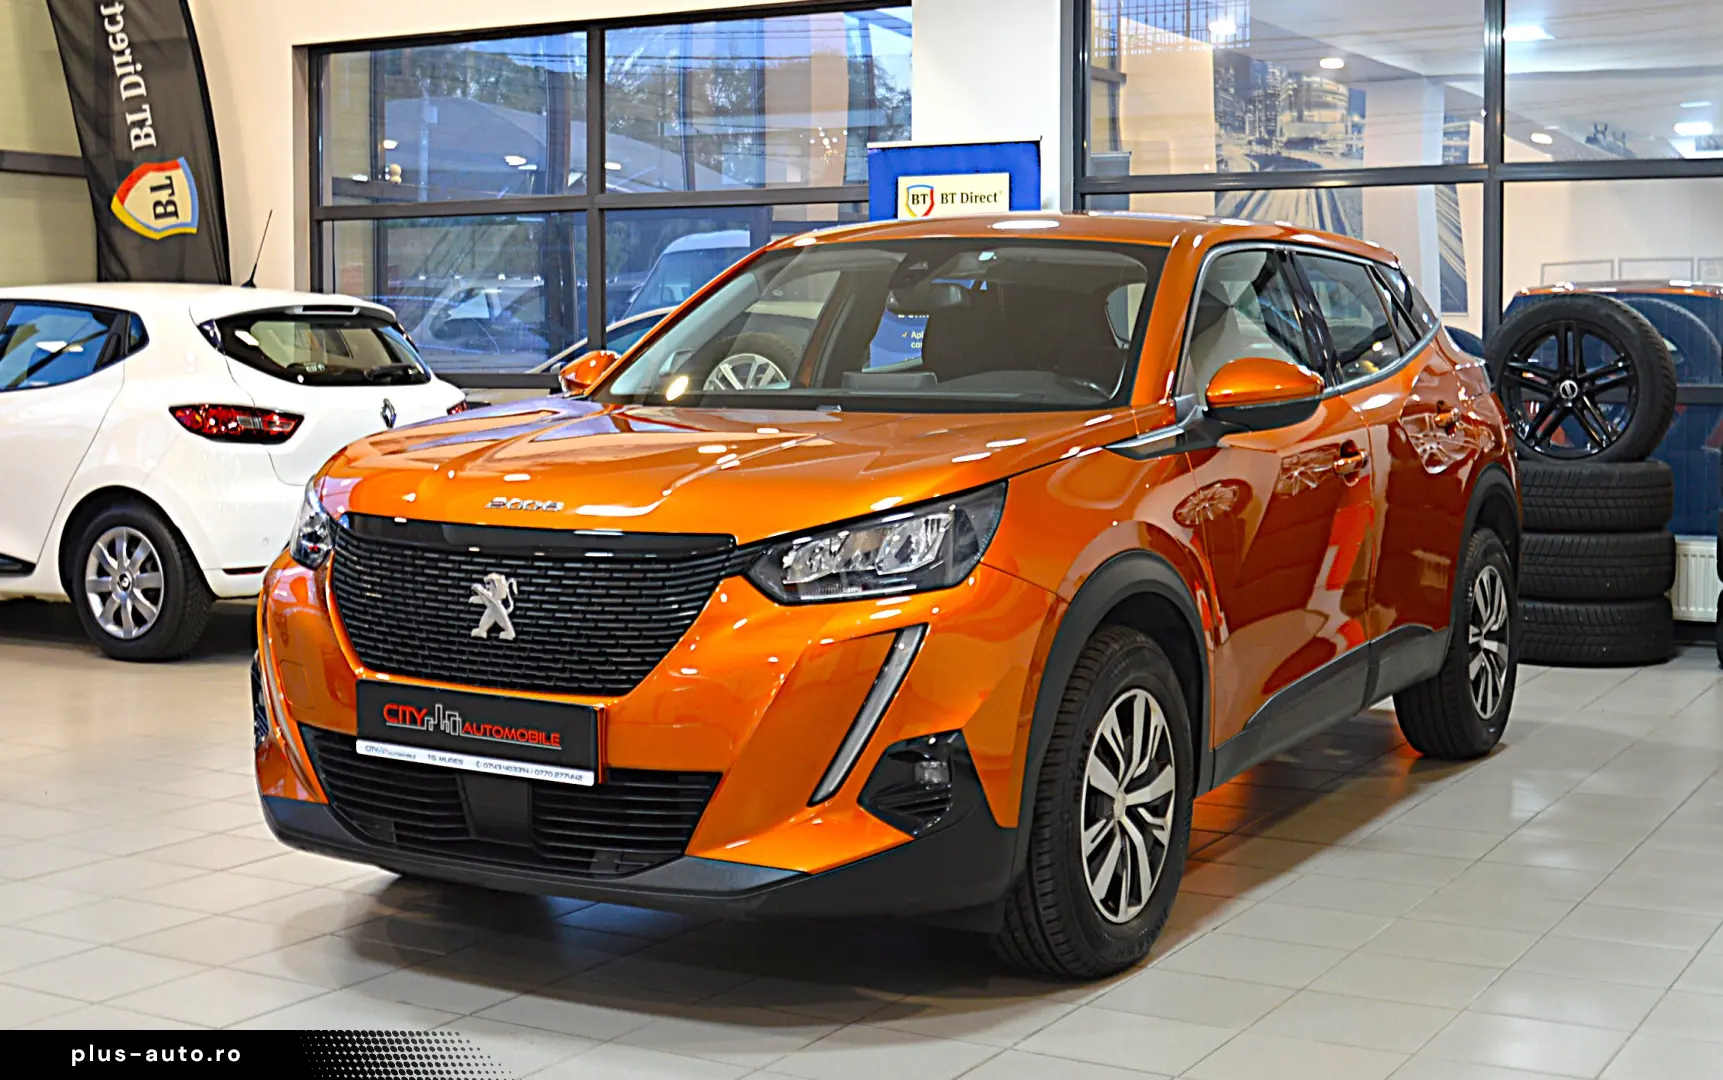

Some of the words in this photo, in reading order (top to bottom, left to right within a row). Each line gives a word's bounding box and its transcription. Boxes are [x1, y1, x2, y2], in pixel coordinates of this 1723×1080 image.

[911, 193, 929, 206] BT
[940, 192, 957, 205] BT
[383, 703, 428, 727] CITY
[462, 721, 561, 747] AUTOMOBILE
